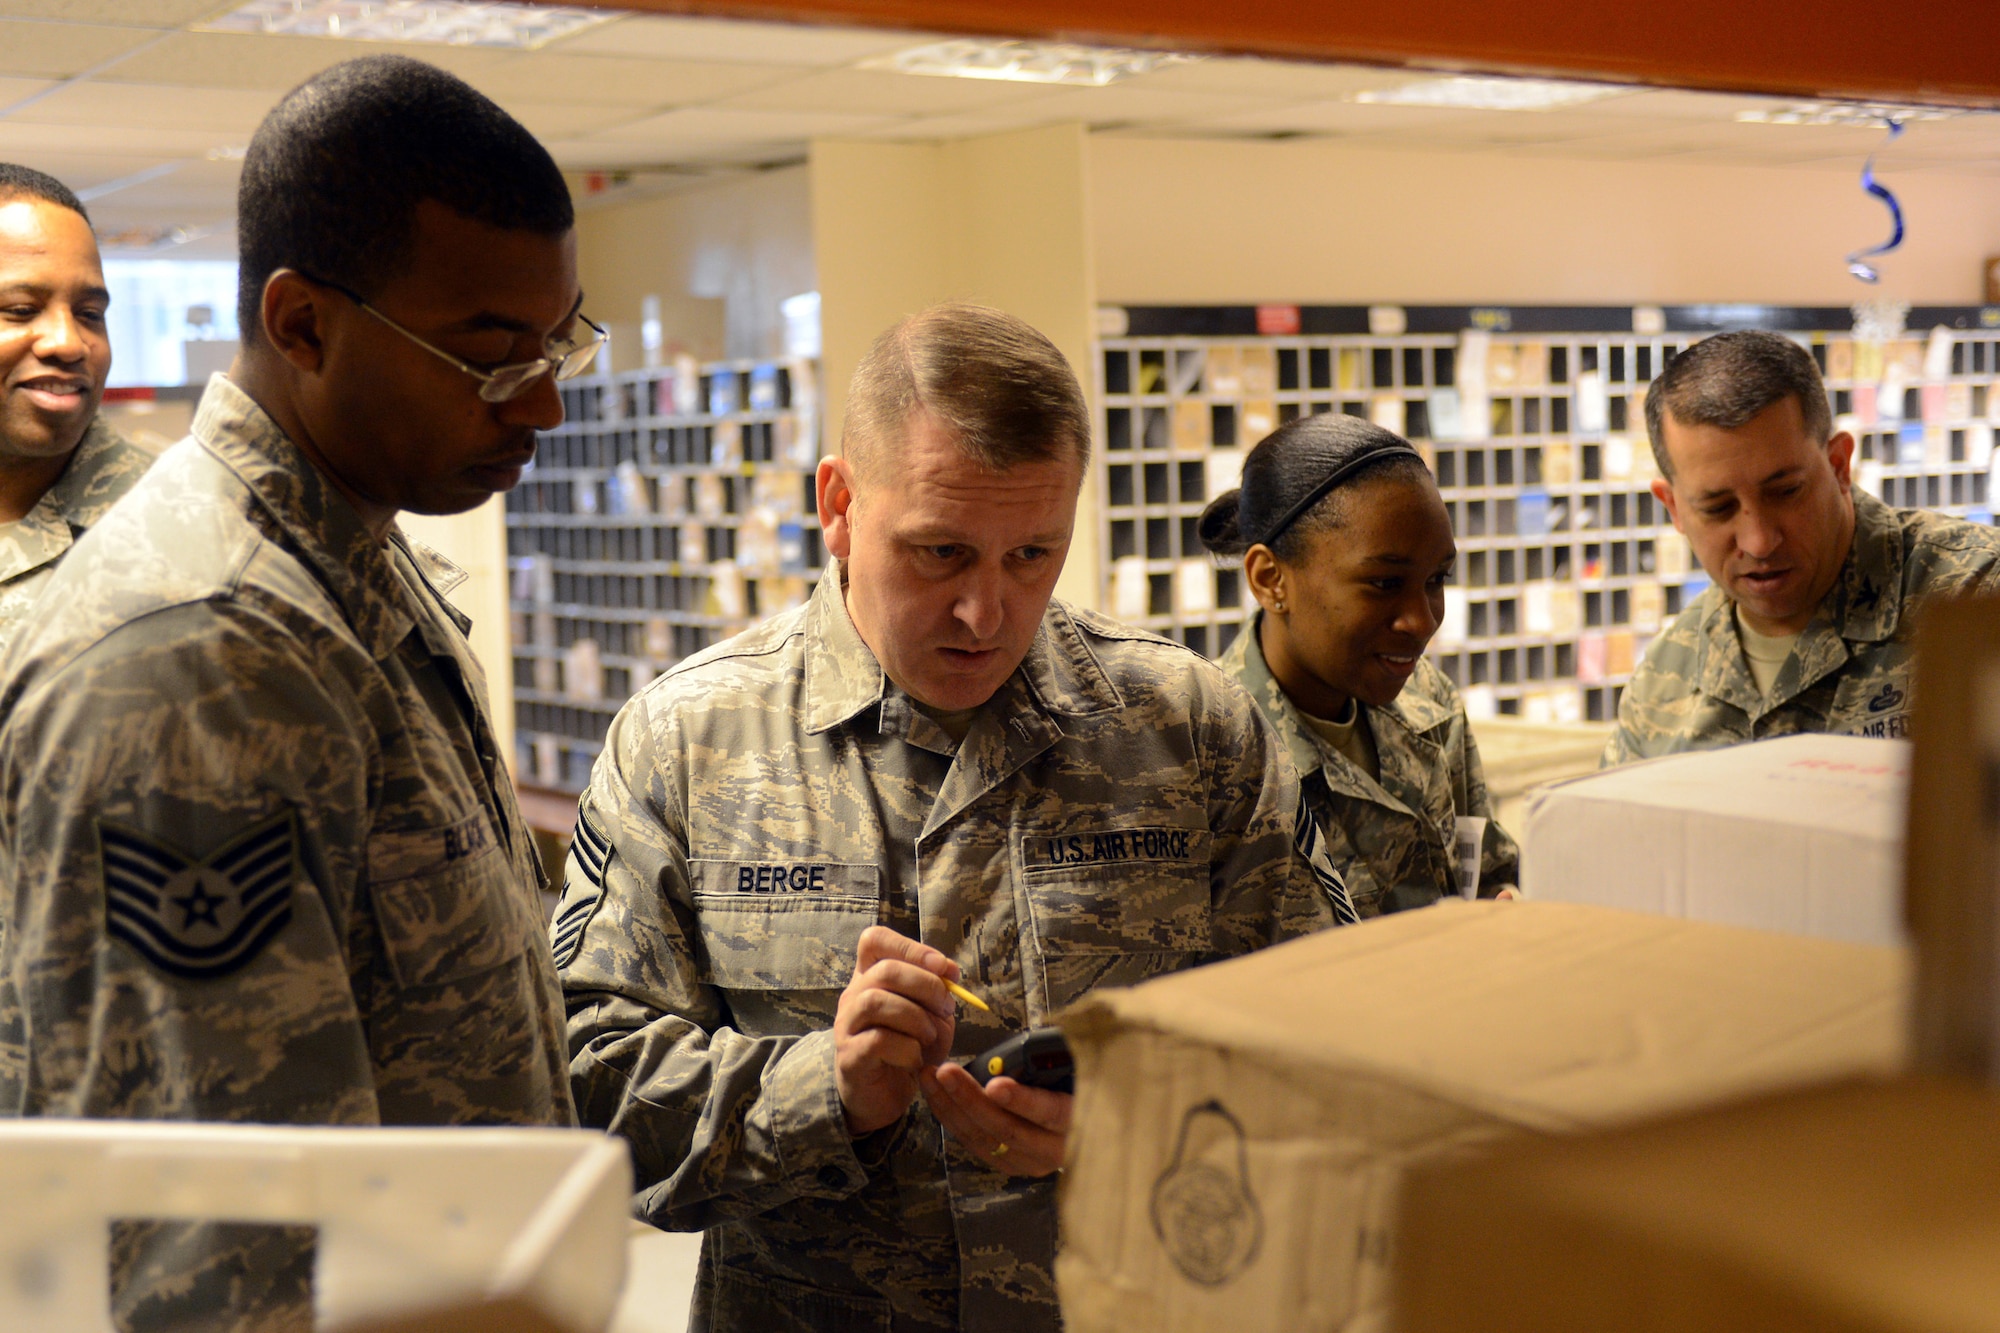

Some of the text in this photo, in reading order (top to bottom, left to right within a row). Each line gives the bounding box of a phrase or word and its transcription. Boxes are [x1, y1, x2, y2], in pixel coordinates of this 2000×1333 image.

[1048, 831, 1190, 864] U.S. AIR FORCE
[737, 865, 826, 893] BERGE
